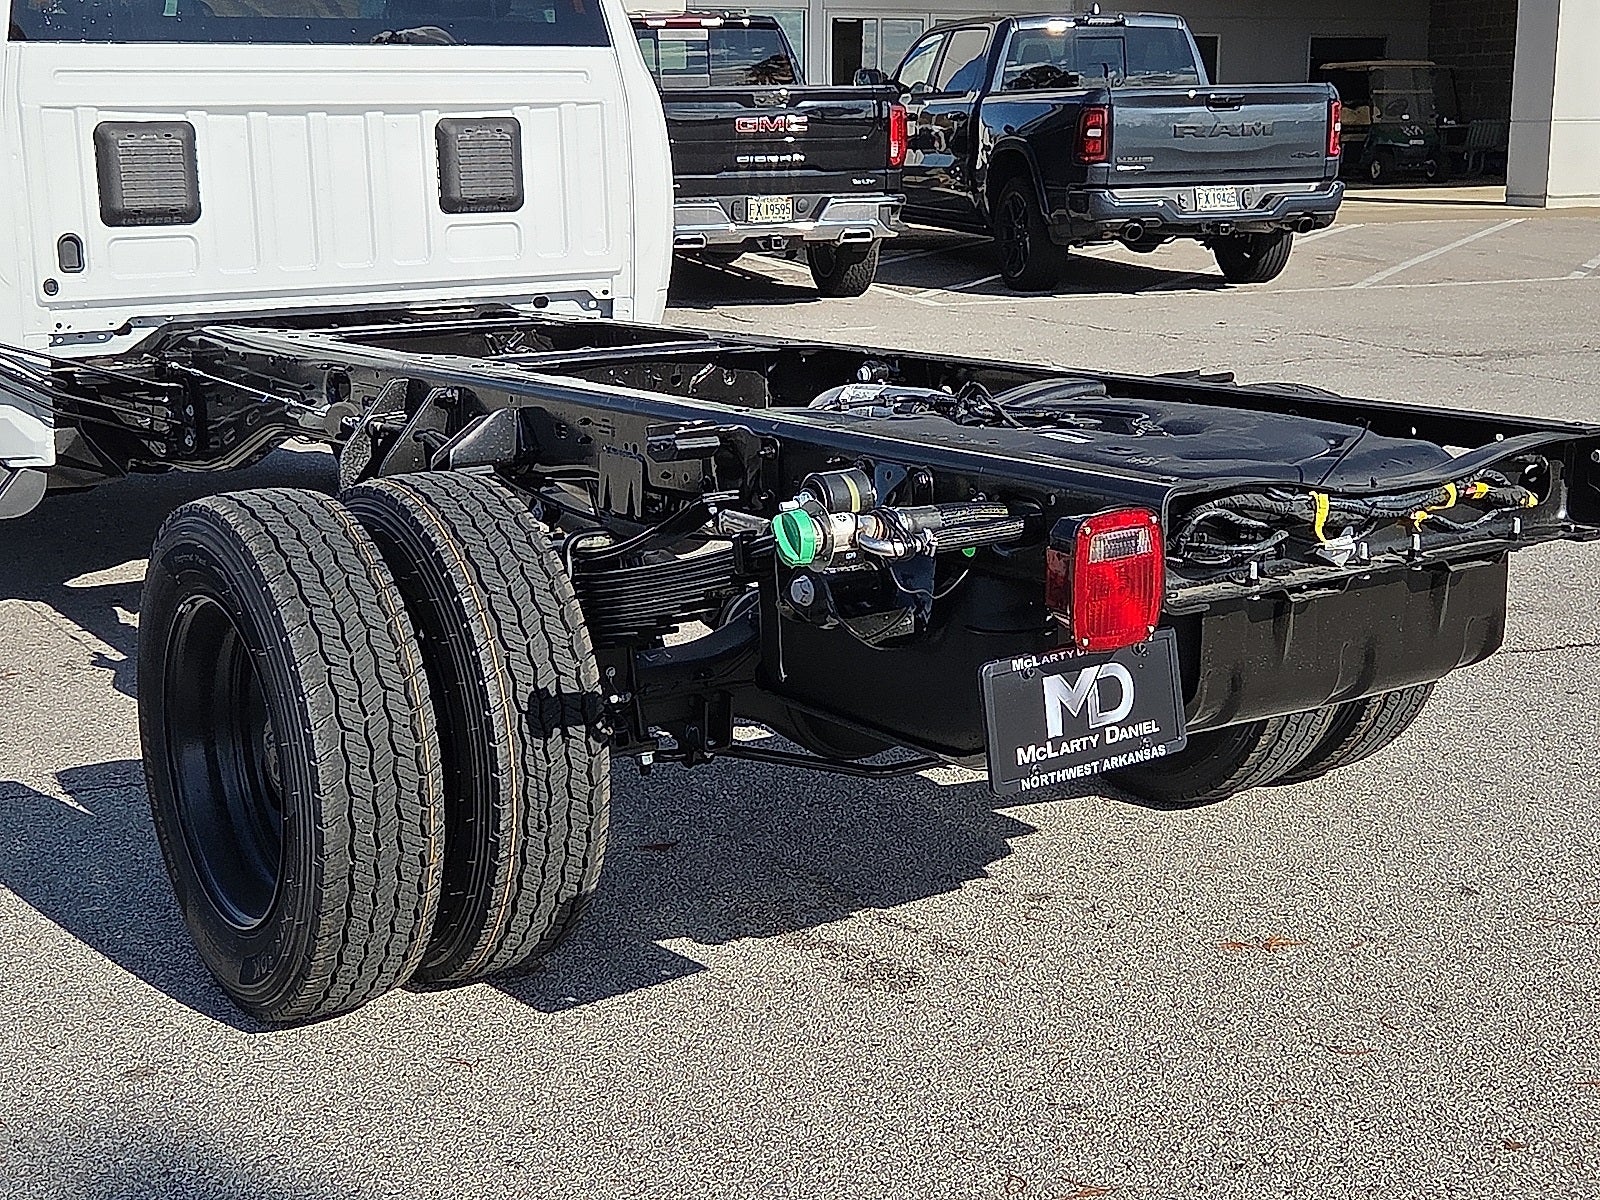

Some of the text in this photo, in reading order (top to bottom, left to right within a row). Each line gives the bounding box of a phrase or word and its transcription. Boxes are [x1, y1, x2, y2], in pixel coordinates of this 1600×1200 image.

[735, 115, 808, 132] GMC
[1173, 122, 1274, 138] RAM
[1042, 661, 1135, 738] MD
[1021, 744, 1167, 791] NORTHWEST ARKANSAS
